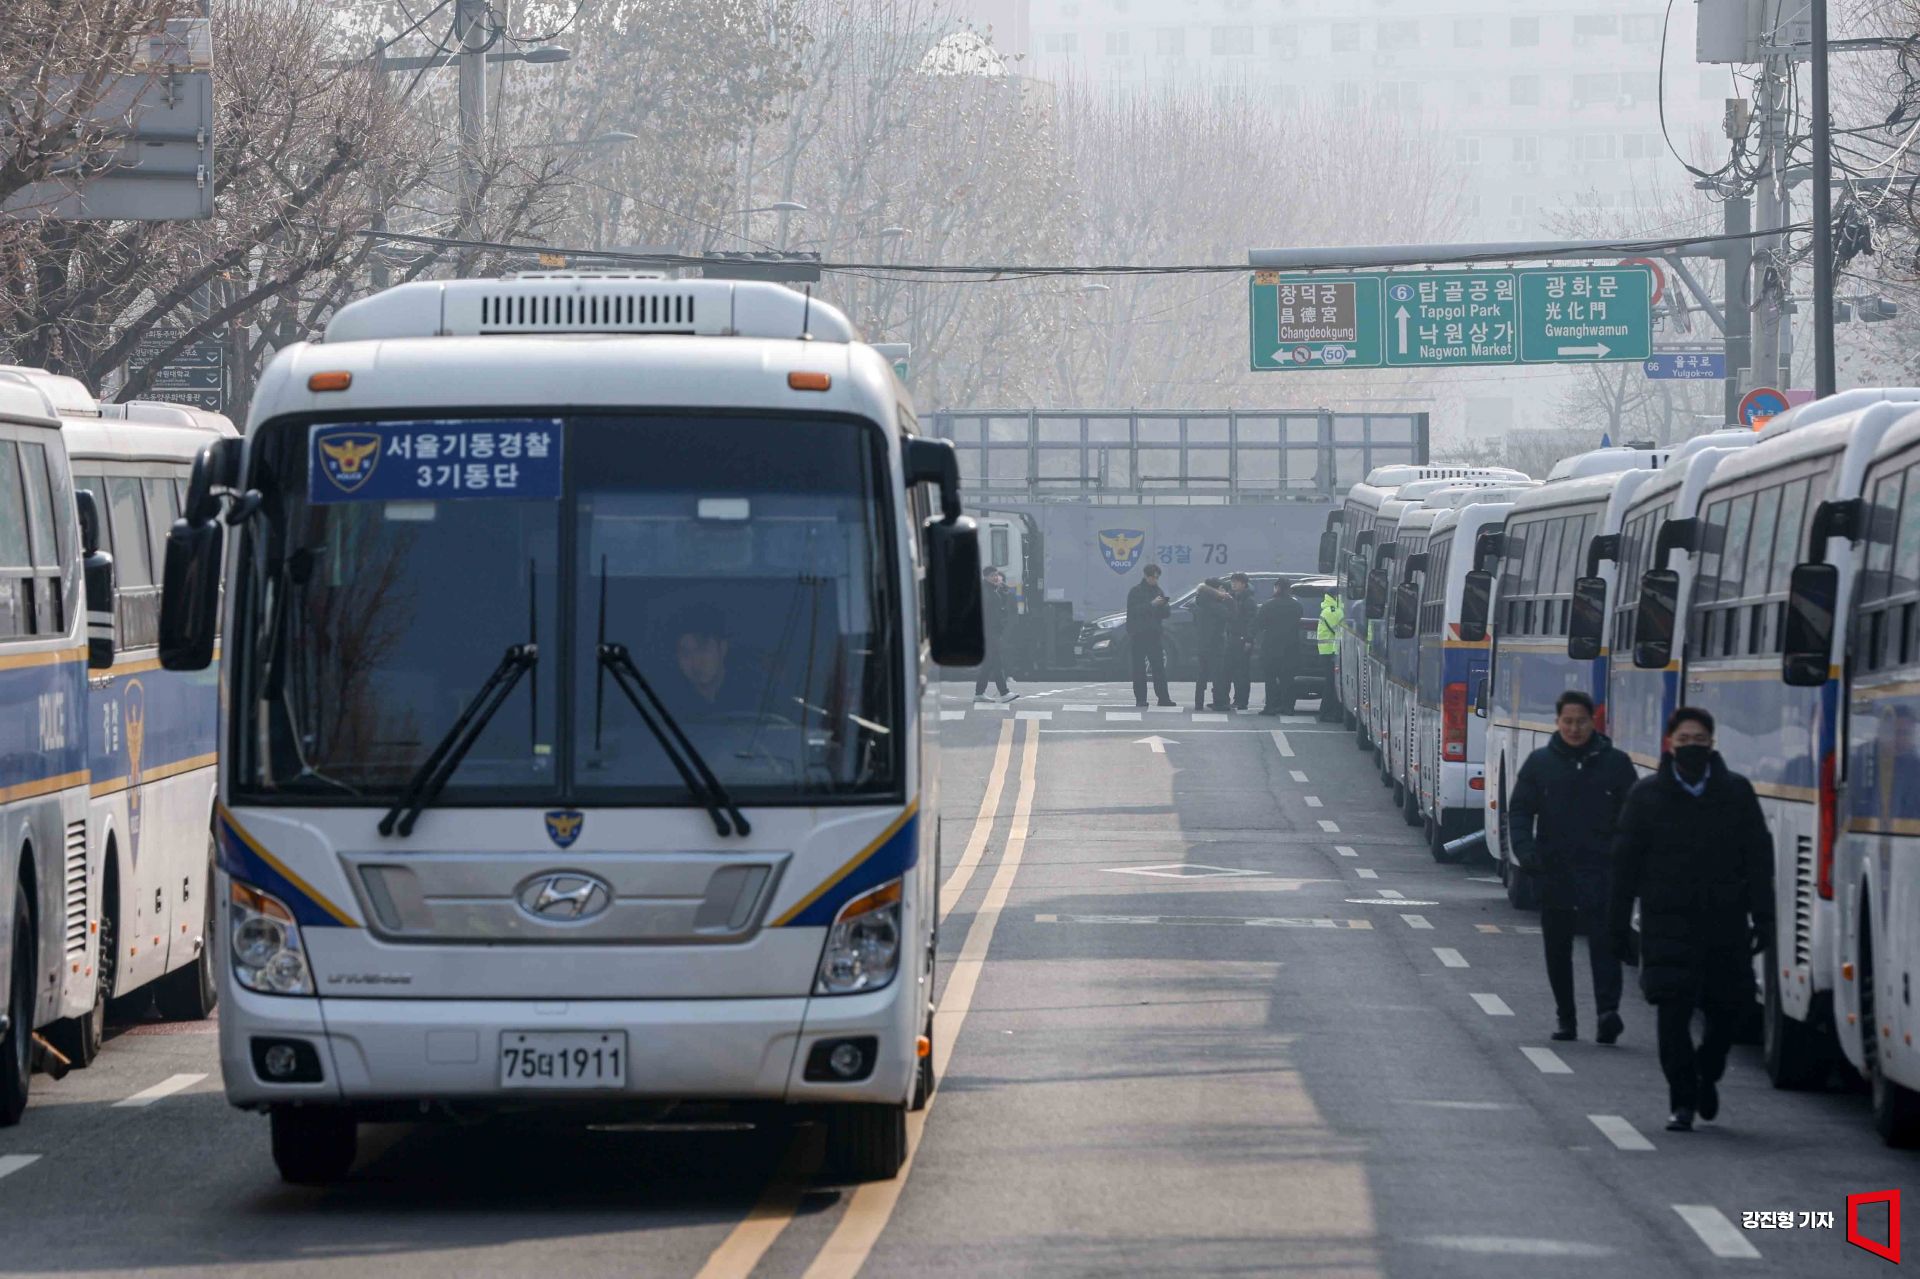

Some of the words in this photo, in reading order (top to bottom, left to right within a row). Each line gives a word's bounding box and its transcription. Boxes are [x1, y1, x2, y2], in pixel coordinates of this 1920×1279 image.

[1280, 284, 1337, 305] 창덕궁
[1397, 286, 1407, 299] 6
[1418, 279, 1513, 303] 탑골공원
[1546, 276, 1618, 298] 광화문
[1420, 304, 1465, 320] Tapgol
[1470, 304, 1500, 317] Park
[1545, 302, 1606, 320] 光化門
[1280, 326, 1354, 341] Changdeokgung
[1419, 321, 1514, 345] 낙원상가
[1545, 324, 1628, 339] Gwanghwamun
[1326, 350, 1343, 360] 50
[1420, 345, 1467, 360] Nagwon
[1471, 343, 1513, 356] Market
[1647, 361, 1660, 371] 66
[1674, 355, 1712, 368] 율곡로
[1672, 370, 1714, 378] Yulgok-ro
[387, 432, 550, 459] 서울기동경찰
[416, 463, 519, 489] 3기동단
[1157, 545, 1192, 564] 경찰
[1202, 544, 1228, 565] 73
